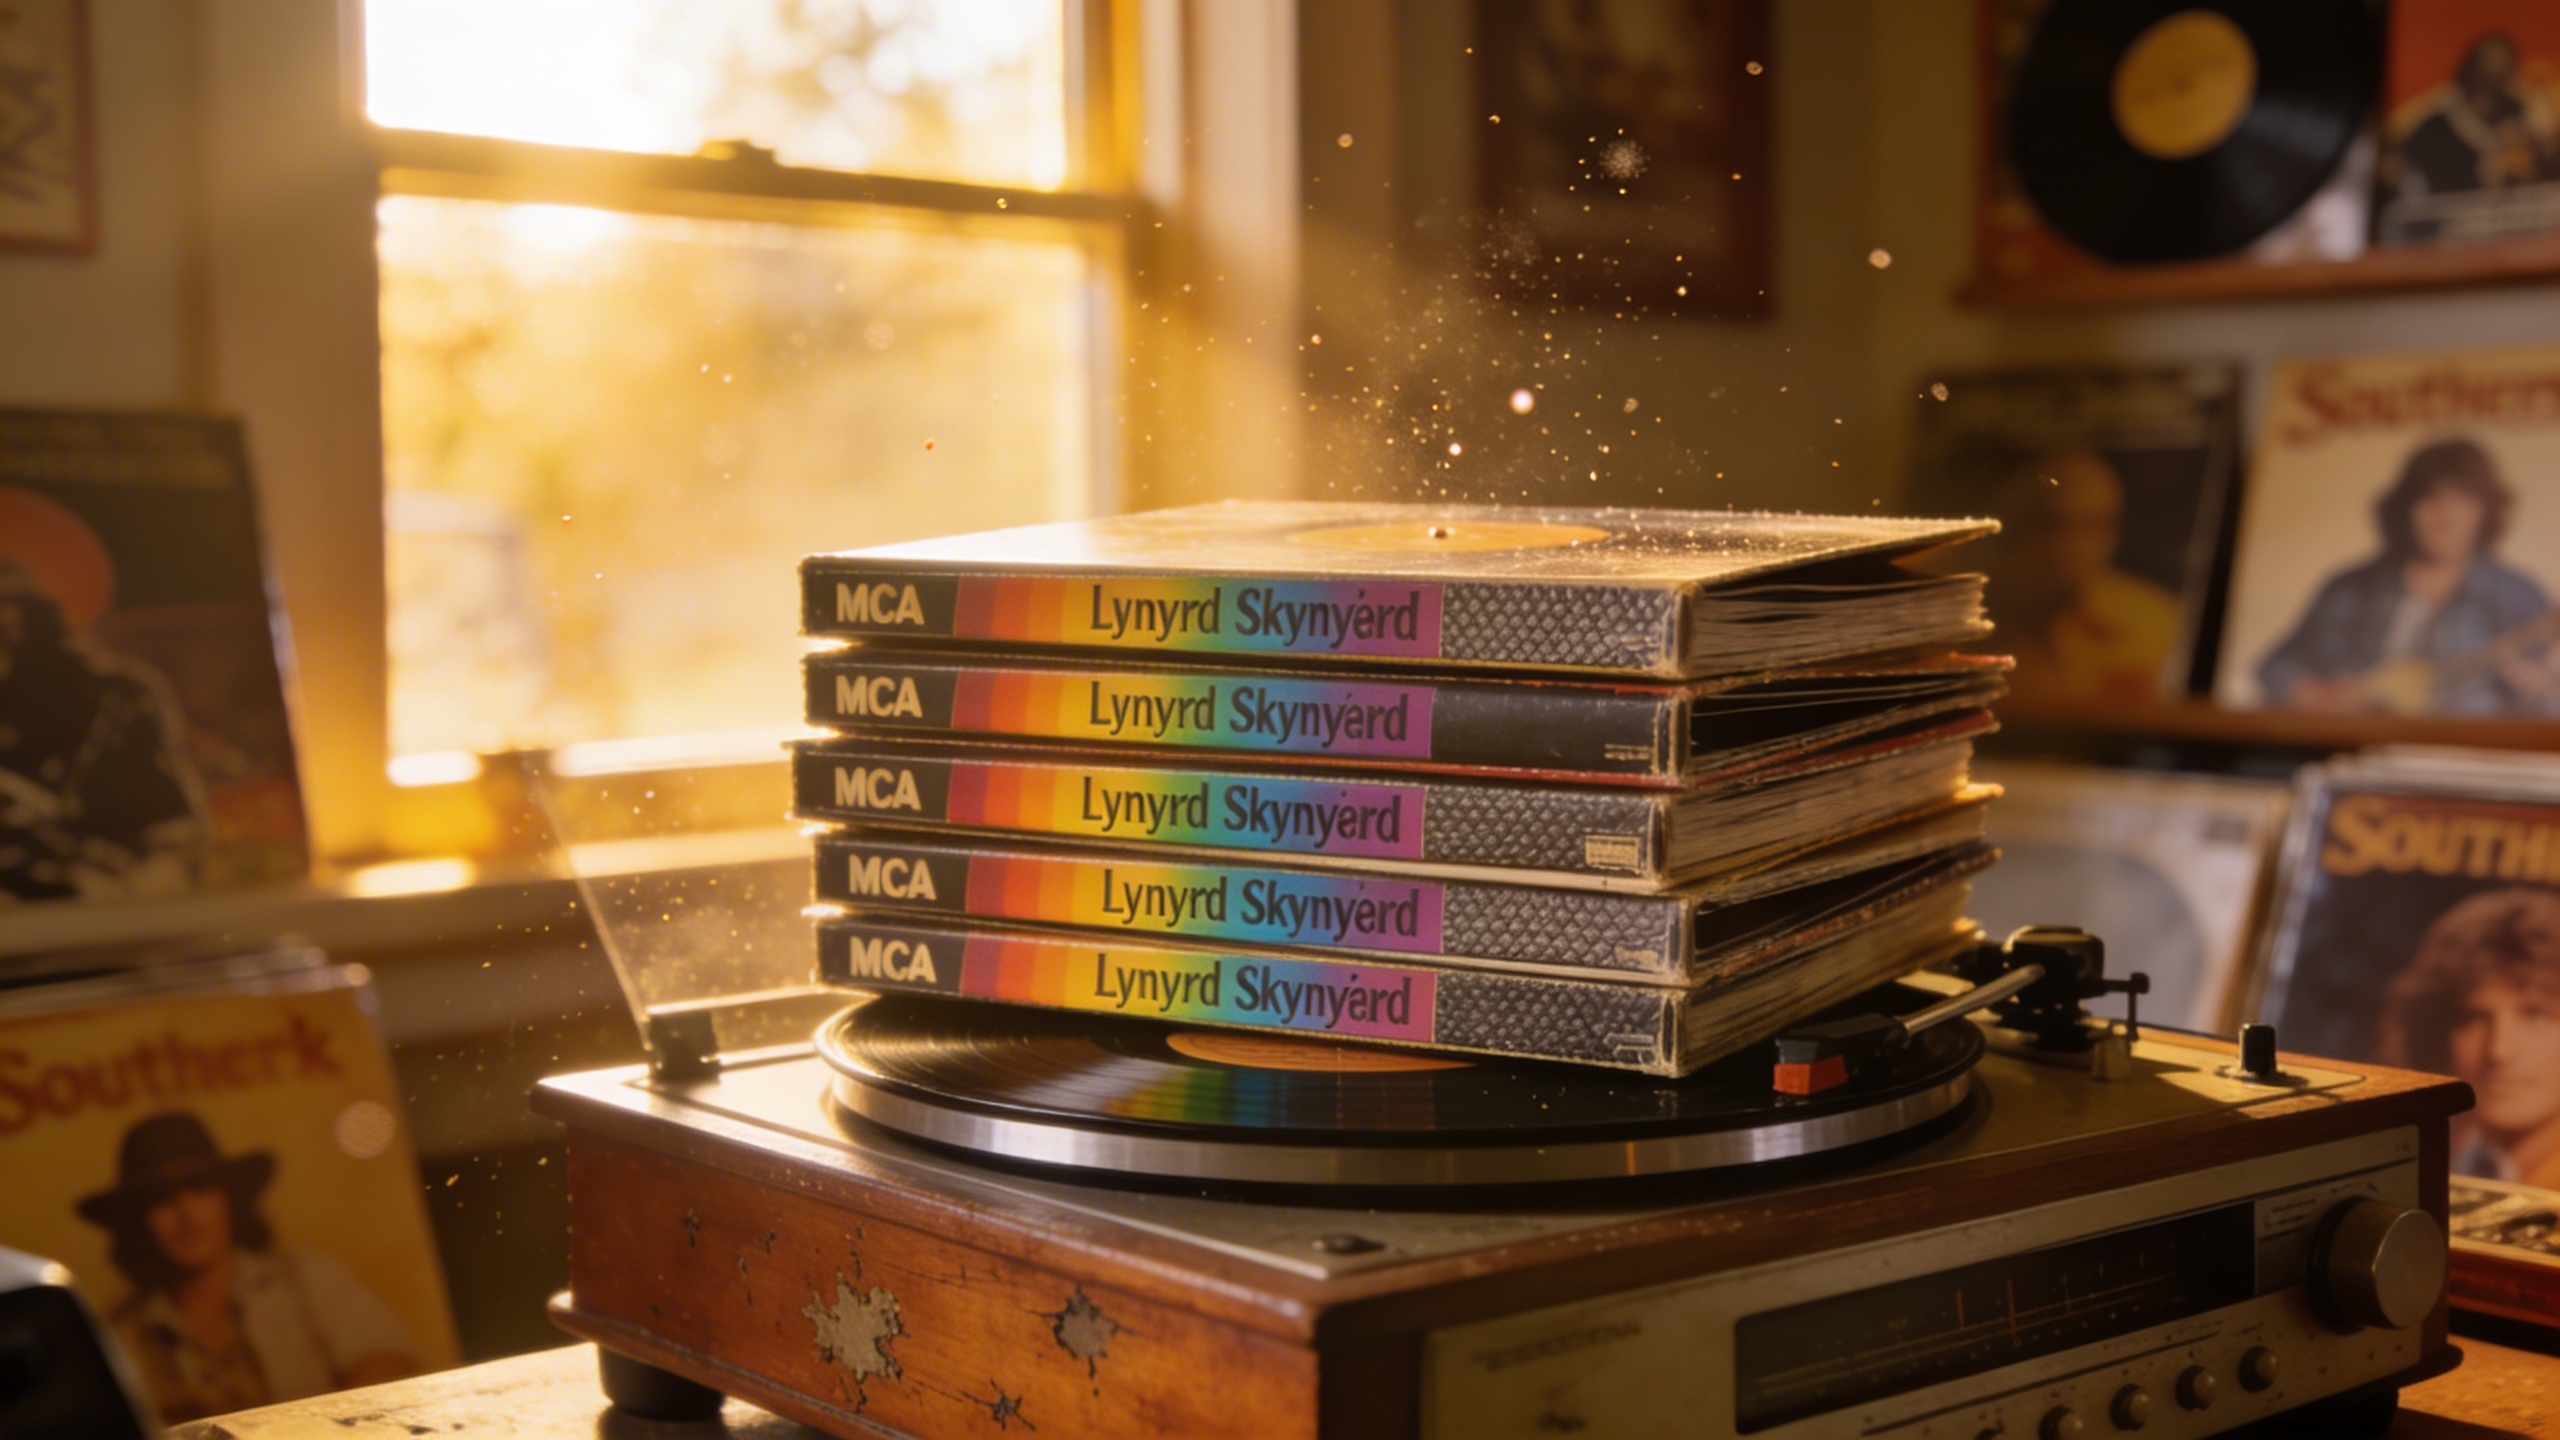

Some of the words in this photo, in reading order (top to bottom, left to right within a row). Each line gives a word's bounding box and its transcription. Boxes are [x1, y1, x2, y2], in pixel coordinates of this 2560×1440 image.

[835, 583, 925, 626] MCA
[1089, 584, 1221, 640] Lynyrd
[834, 675, 923, 719] MCA
[1088, 681, 1216, 738] Lynyrd
[833, 767, 922, 812] MCA
[1081, 776, 1209, 835] Lynyrd
[848, 854, 937, 901] MCA
[1101, 868, 1228, 926] Lynyrd
[849, 936, 937, 984] MCA
[1093, 953, 1221, 1012] Lynyrd
